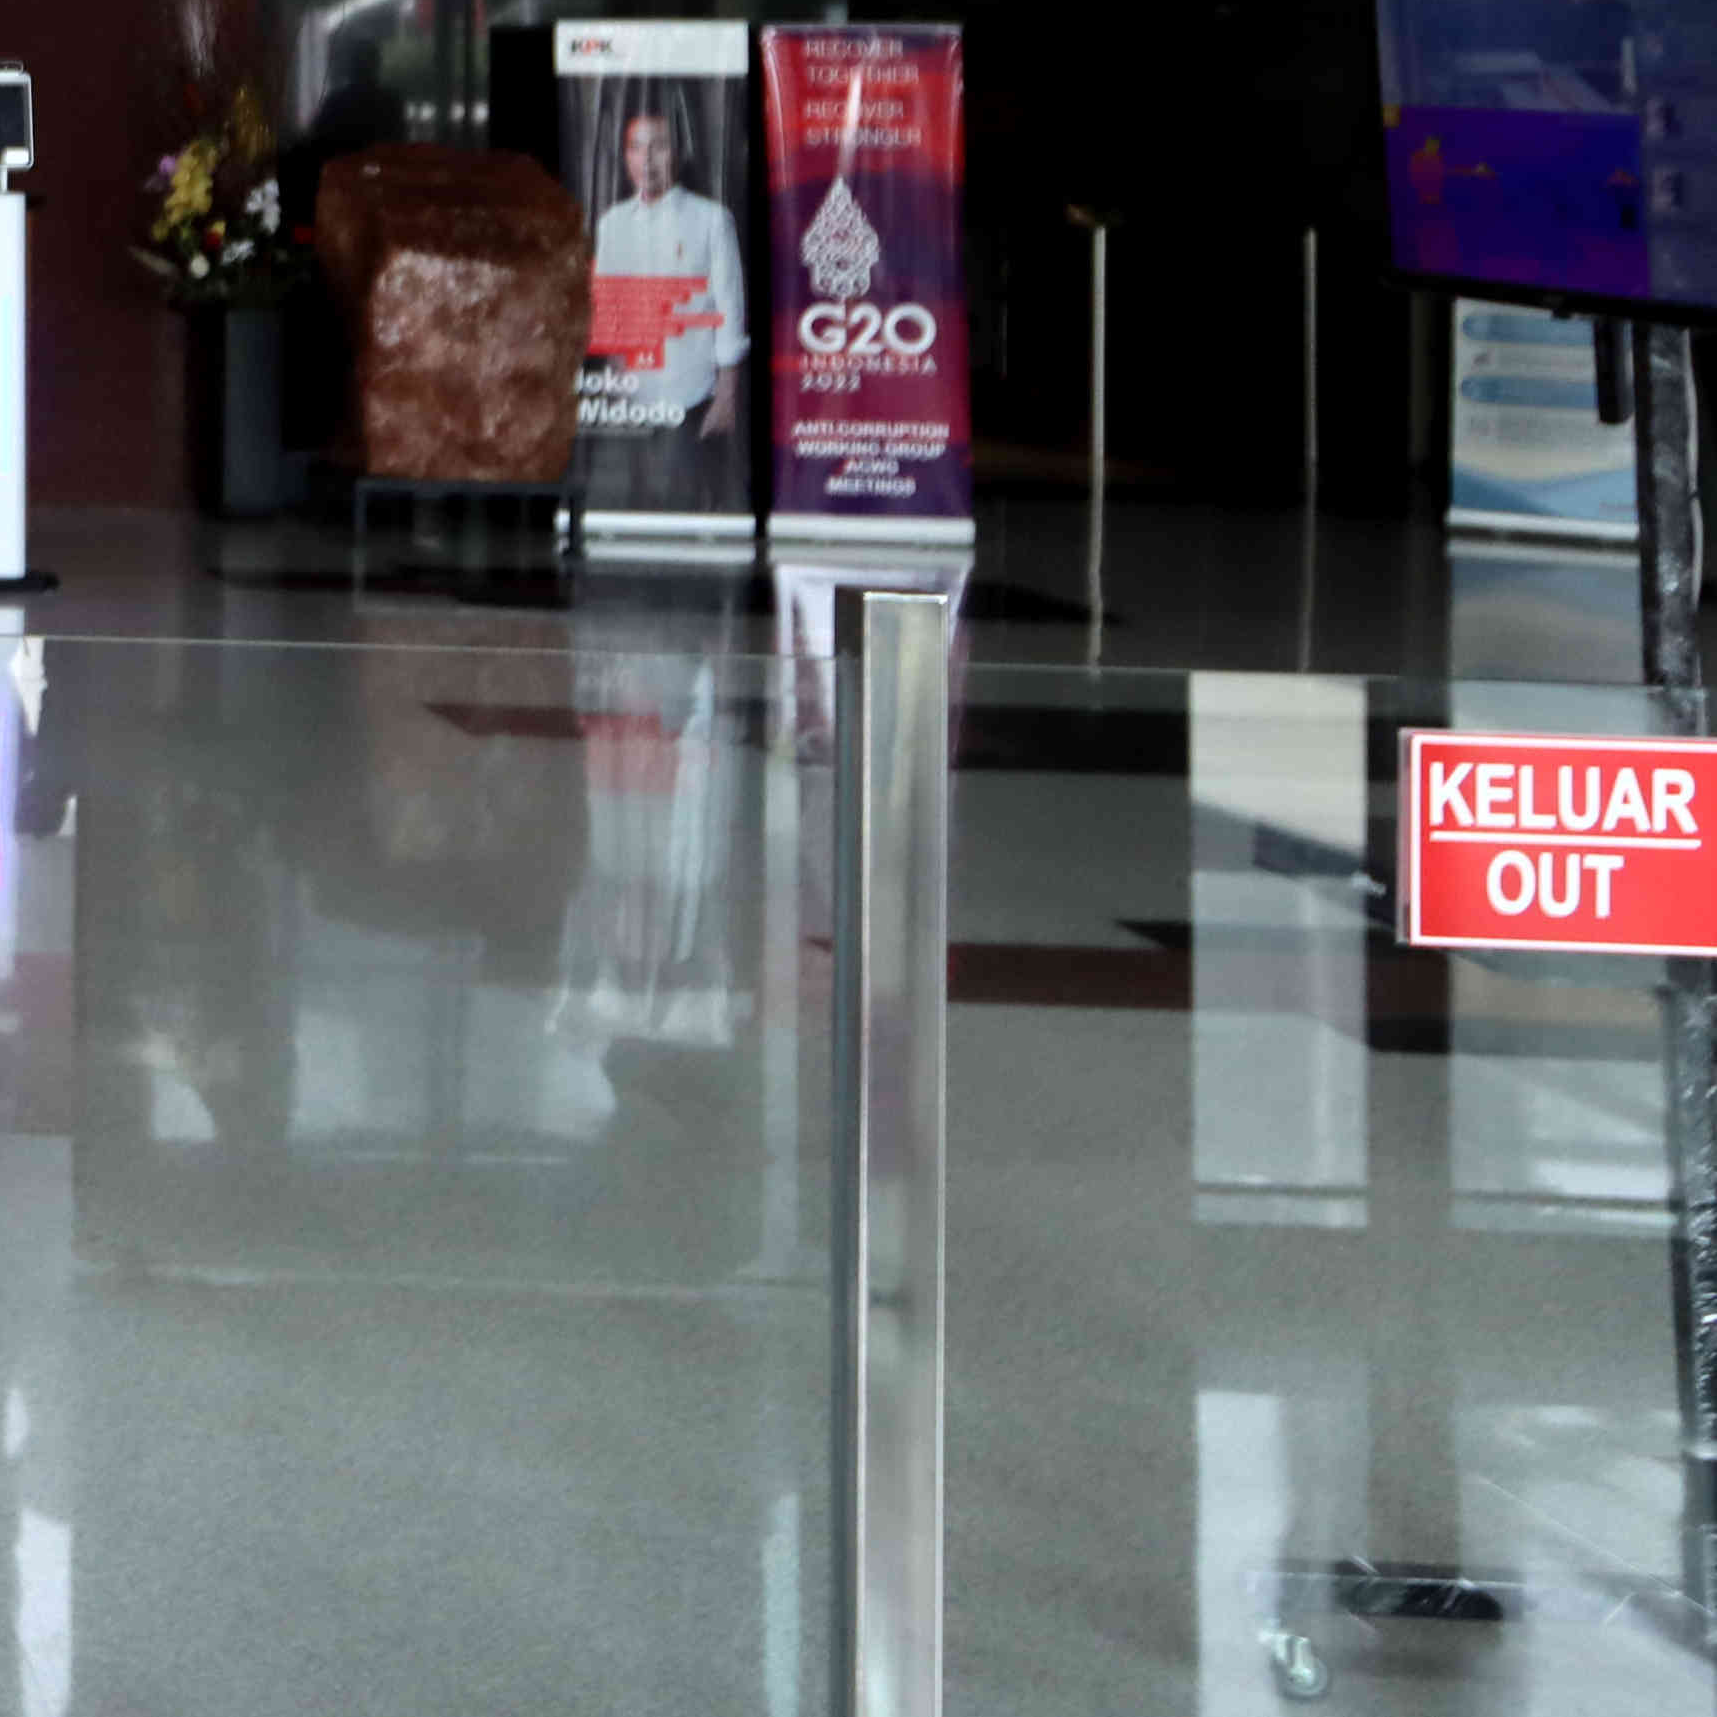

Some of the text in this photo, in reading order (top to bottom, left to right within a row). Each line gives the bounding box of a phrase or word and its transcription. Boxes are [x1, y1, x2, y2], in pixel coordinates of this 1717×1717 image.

[806, 101, 905, 122] RECVER
[799, 302, 938, 355] G20
[801, 355, 938, 376] INDONESIA
[802, 373, 861, 393] 2022
[798, 440, 947, 459] WORKING GROUP
[825, 477, 917, 497] MEETINGS
[1429, 761, 1698, 834] KELUAR
[1486, 850, 1625, 919] OUT
